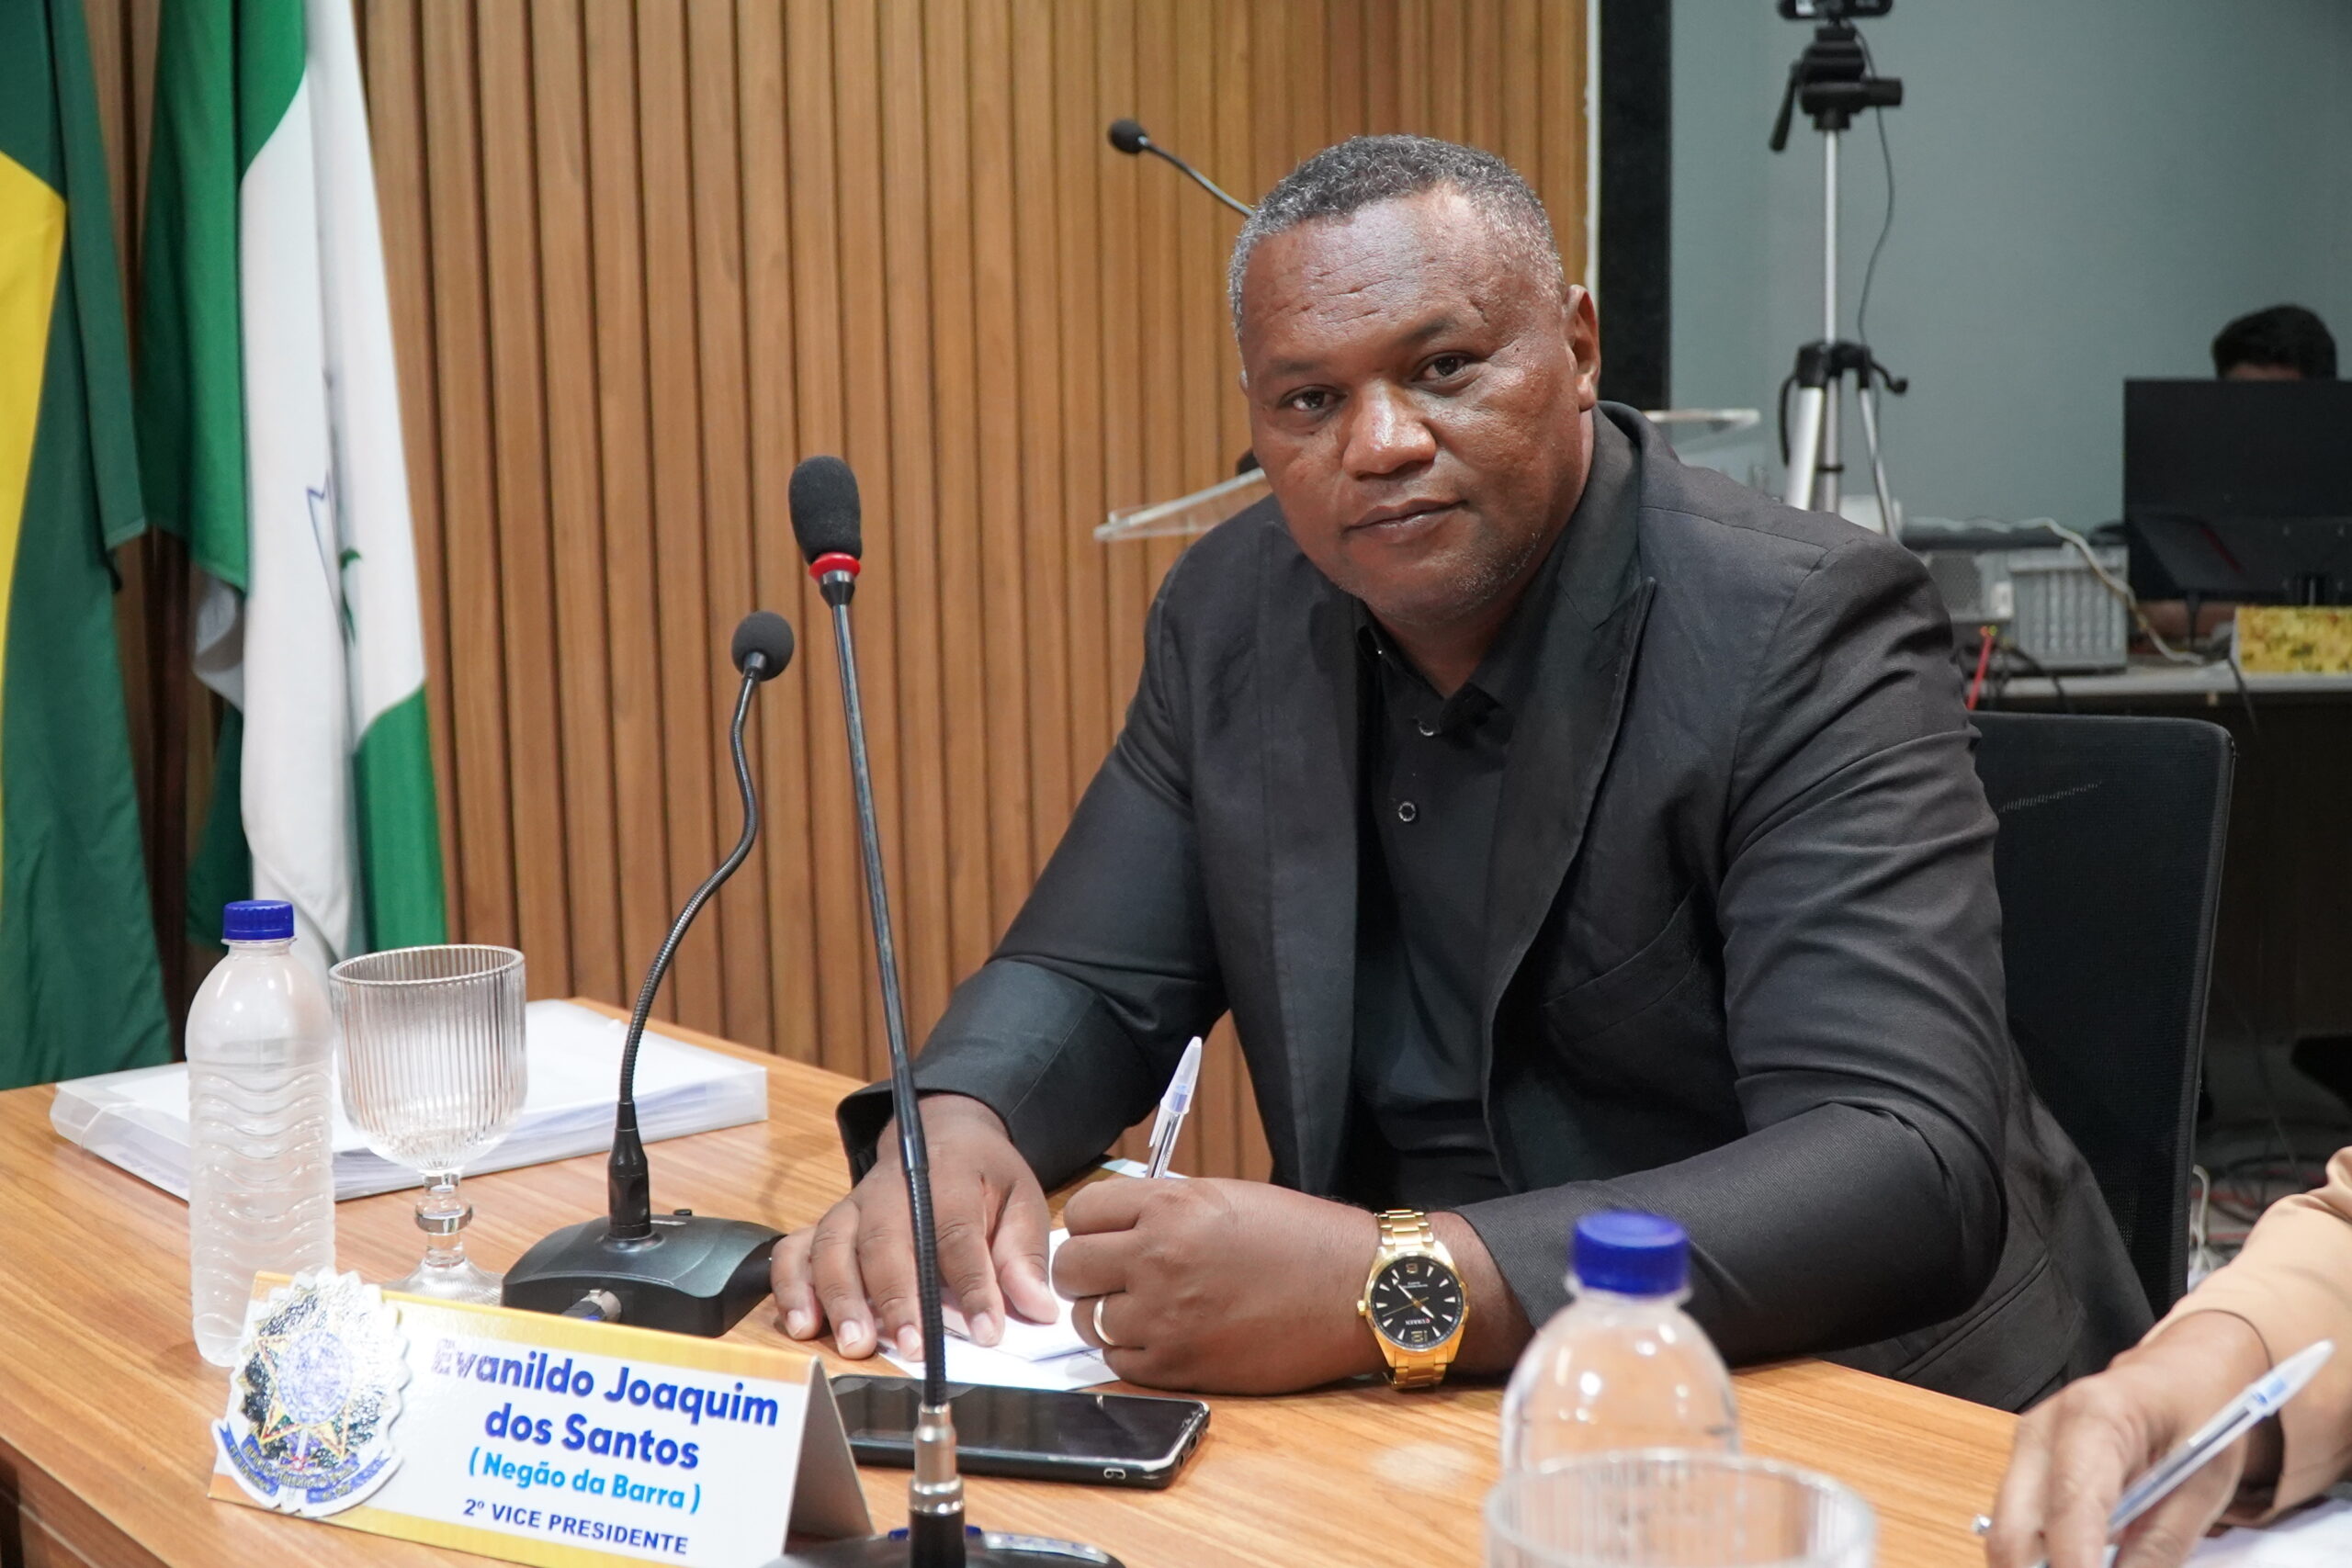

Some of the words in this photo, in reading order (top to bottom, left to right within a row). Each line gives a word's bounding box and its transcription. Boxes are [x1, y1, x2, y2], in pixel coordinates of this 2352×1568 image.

[431, 1338, 594, 1397] Evanildo
[604, 1367, 778, 1426] Joaquim
[484, 1403, 553, 1446] dos
[561, 1413, 700, 1470] Santos
[571, 1469, 605, 1495] da
[492, 1504, 542, 1529] VICE
[548, 1514, 689, 1554] PRESIDENTE
